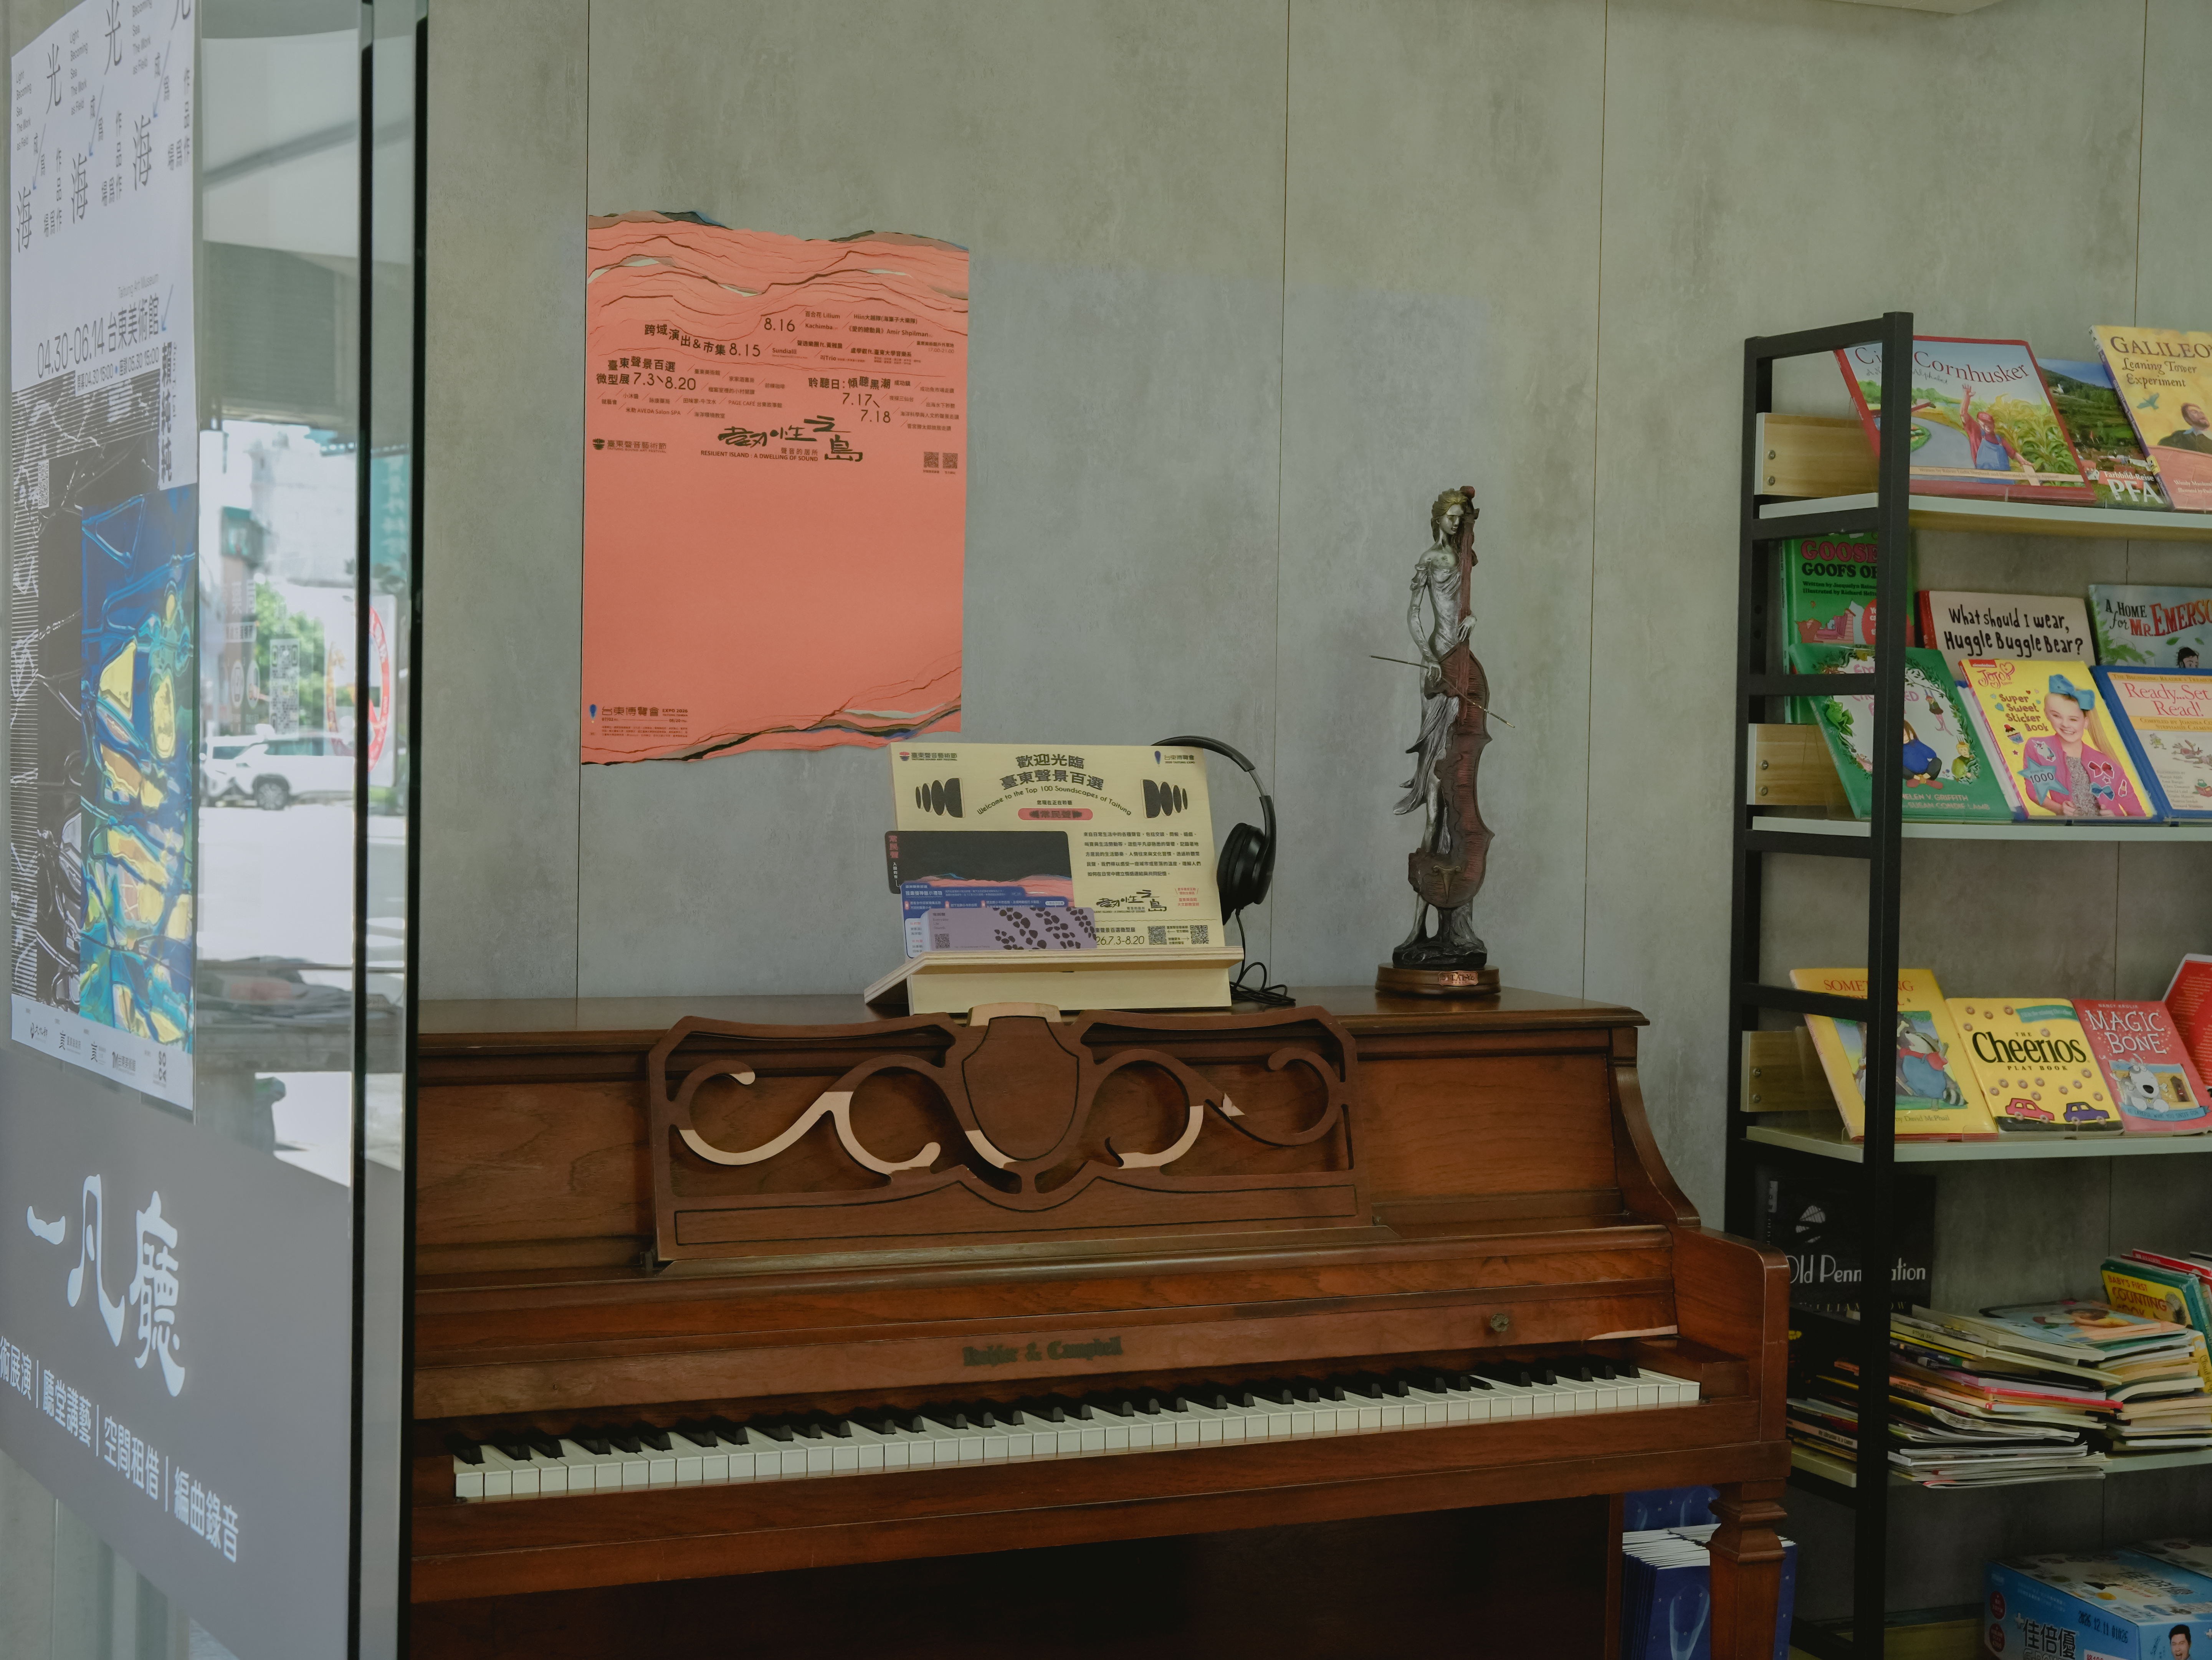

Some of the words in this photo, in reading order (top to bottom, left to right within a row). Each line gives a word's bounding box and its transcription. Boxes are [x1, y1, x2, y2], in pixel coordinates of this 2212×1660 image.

[46, 43, 62, 114] 光
[133, 115, 152, 191] 海
[71, 153, 88, 224] 海
[17, 186, 31, 253] 海
[764, 317, 795, 332] 8.16
[38, 317, 104, 378] 04.30-06.14
[108, 293, 159, 352] 台東美術館
[729, 343, 760, 357] 8.15
[608, 356, 676, 373] 臺東聲景百選
[1914, 351, 2029, 383] Cornhusker
[2122, 358, 2162, 374] Leaning
[2165, 361, 2196, 374] Tower
[596, 373, 630, 385] 微型展
[2127, 373, 2186, 388] Experiment
[861, 409, 891, 423] 7.18
[607, 440, 666, 449] 臺東聲音藝術節
[780, 447, 818, 456] 聲音的居所
[1802, 563, 1857, 577] GOOFS
[2105, 599, 2113, 613] A
[2117, 601, 2147, 618] HOME
[1949, 605, 1980, 625] What
[1984, 608, 2020, 628] should
[2024, 614, 2030, 627] I
[2033, 614, 2070, 633] wear,
[2110, 611, 2129, 629] for
[1944, 630, 1992, 656] Huggle
[1995, 632, 2042, 658] Buggle
[2043, 635, 2083, 655] Bear?
[1999, 694, 2029, 704] Super
[602, 706, 659, 716] 台東博覽會
[2007, 703, 2039, 713] Sweet
[2151, 700, 2204, 717] Read!
[2005, 713, 2040, 723] Sticker
[2025, 722, 2048, 732] Book
[1016, 753, 1085, 769] 歡迎光臨
[999, 769, 1104, 791] 臺東聲景百選
[2029, 772, 2054, 784] 1000
[977, 797, 1004, 815] Welcome
[1055, 785, 1098, 799] Soundscapes
[1109, 798, 1131, 816] Taitung
[2086, 1010, 2165, 1032] MAGIC
[1972, 1032, 2087, 1064] Cheerios
[2105, 1032, 2166, 1054] BONE
[2108, 1274, 2130, 1287] BABY'S
[2131, 1280, 2148, 1292] FIRST
[2112, 1287, 2167, 1312] COUNTING
[104, 1416, 159, 1500] 空間租借
[174, 1466, 238, 1562] 編曲錄音
[2023, 1618, 2076, 1659] 佳倍優
